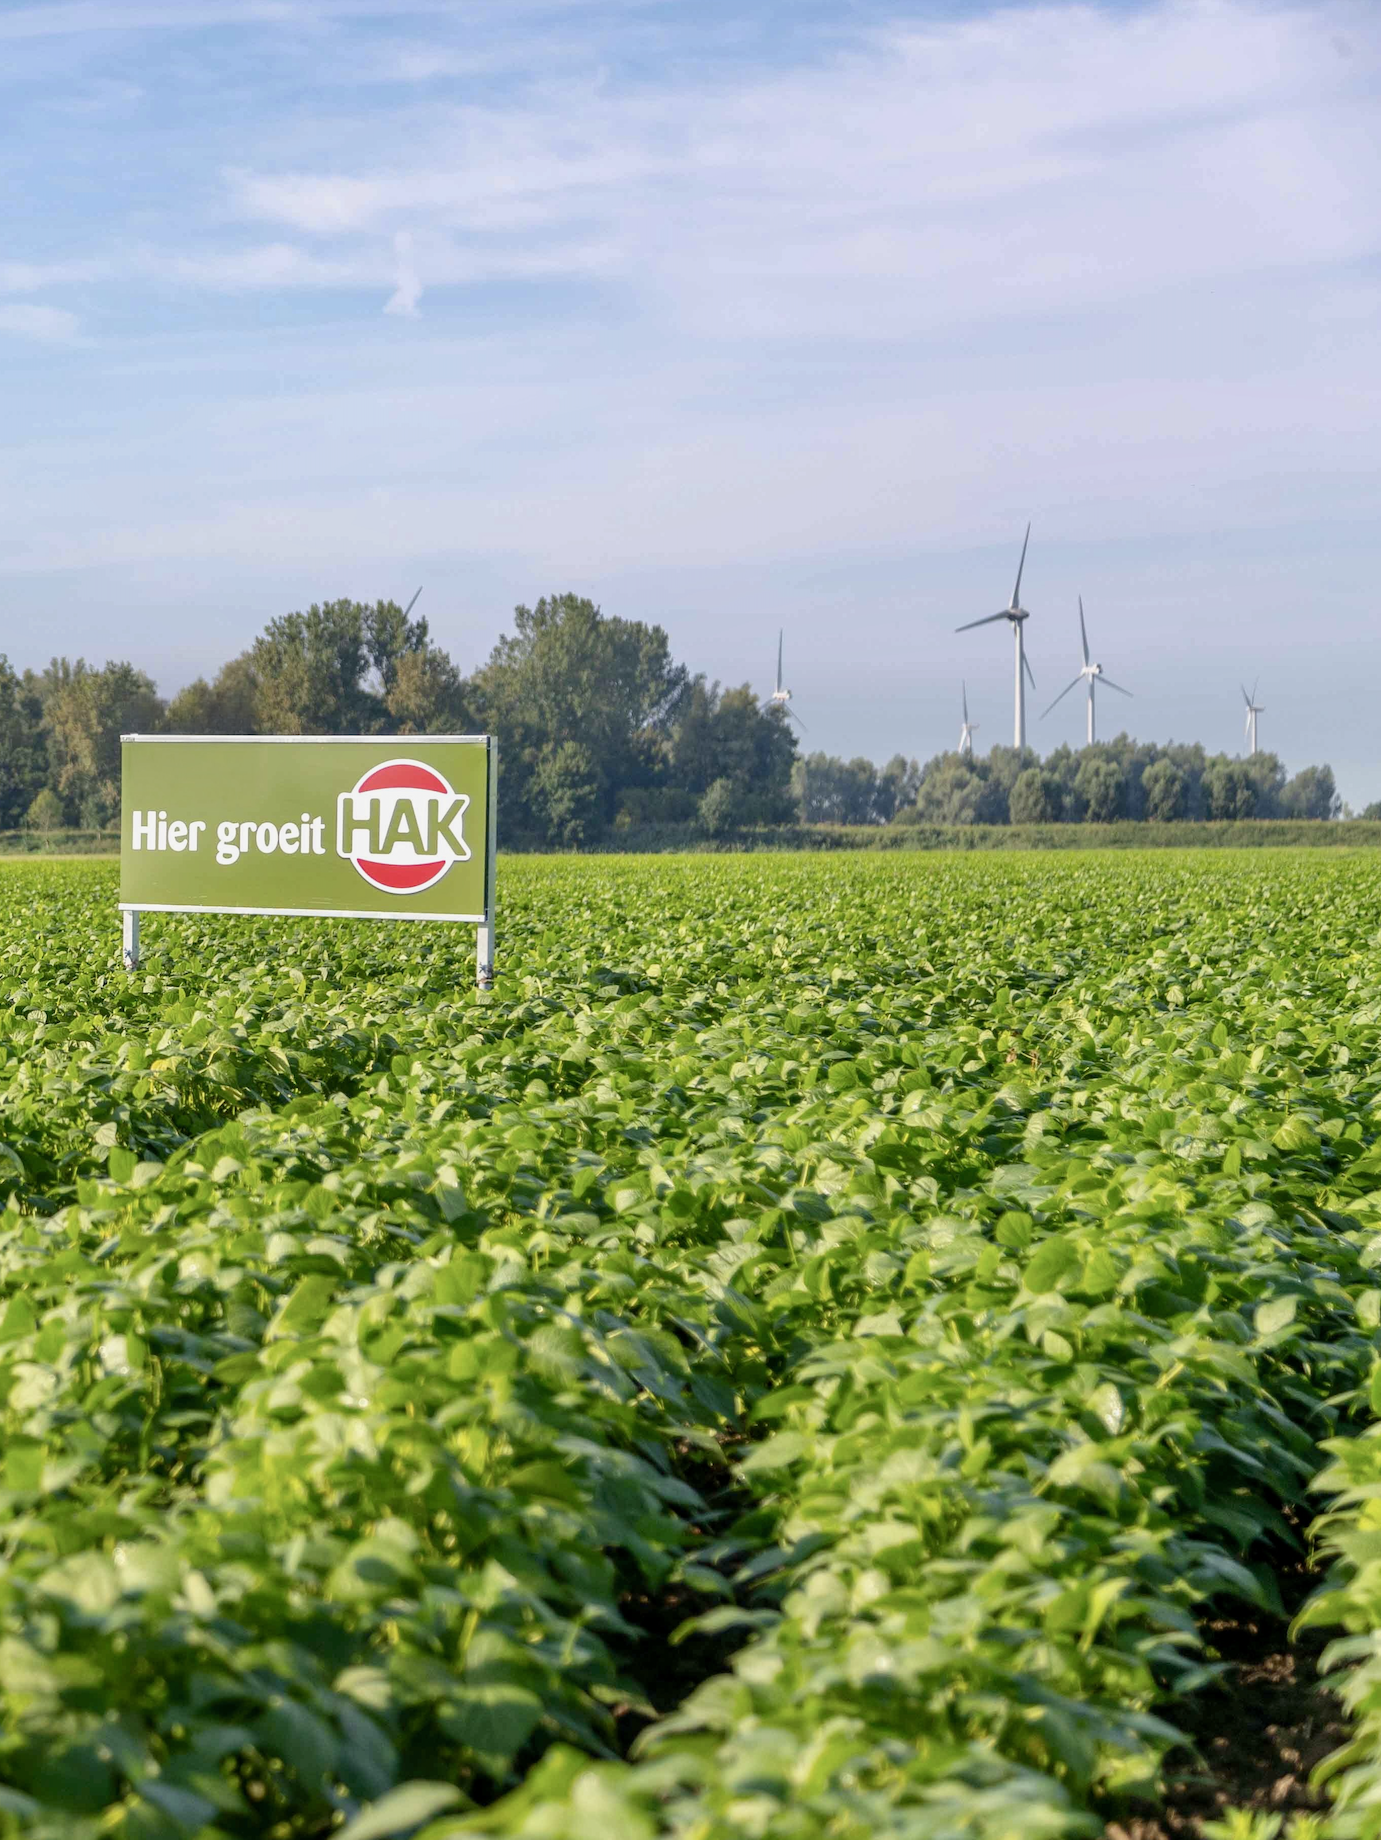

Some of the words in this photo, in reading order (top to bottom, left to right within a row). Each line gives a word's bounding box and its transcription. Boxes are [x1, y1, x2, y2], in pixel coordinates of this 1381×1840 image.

[132, 810, 206, 852] Hier
[216, 812, 326, 865] groeit
[342, 798, 467, 856] HAK
